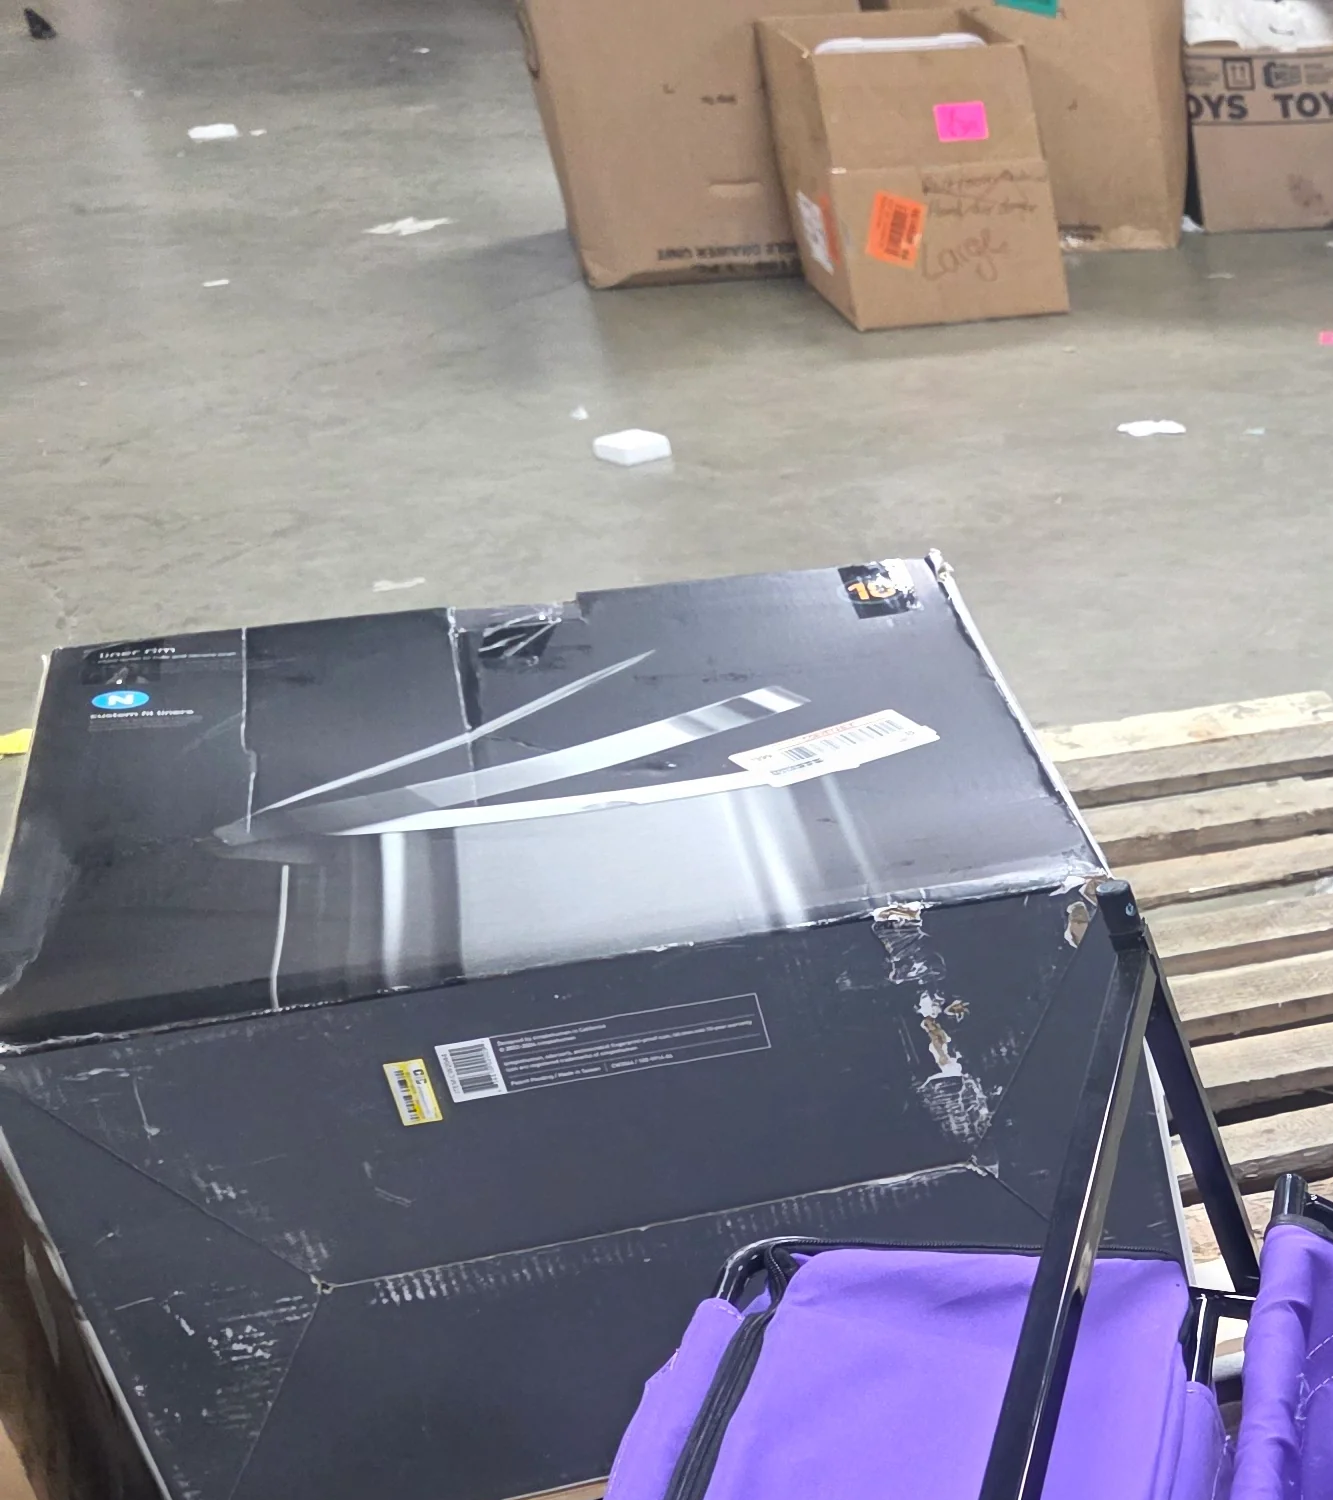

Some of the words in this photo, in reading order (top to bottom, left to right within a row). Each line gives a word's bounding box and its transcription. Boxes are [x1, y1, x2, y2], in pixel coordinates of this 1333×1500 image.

[1187, 93, 1248, 120] OYS
[144, 647, 176, 656] rim
[90, 712, 139, 720] custom
[156, 708, 195, 716] liners
